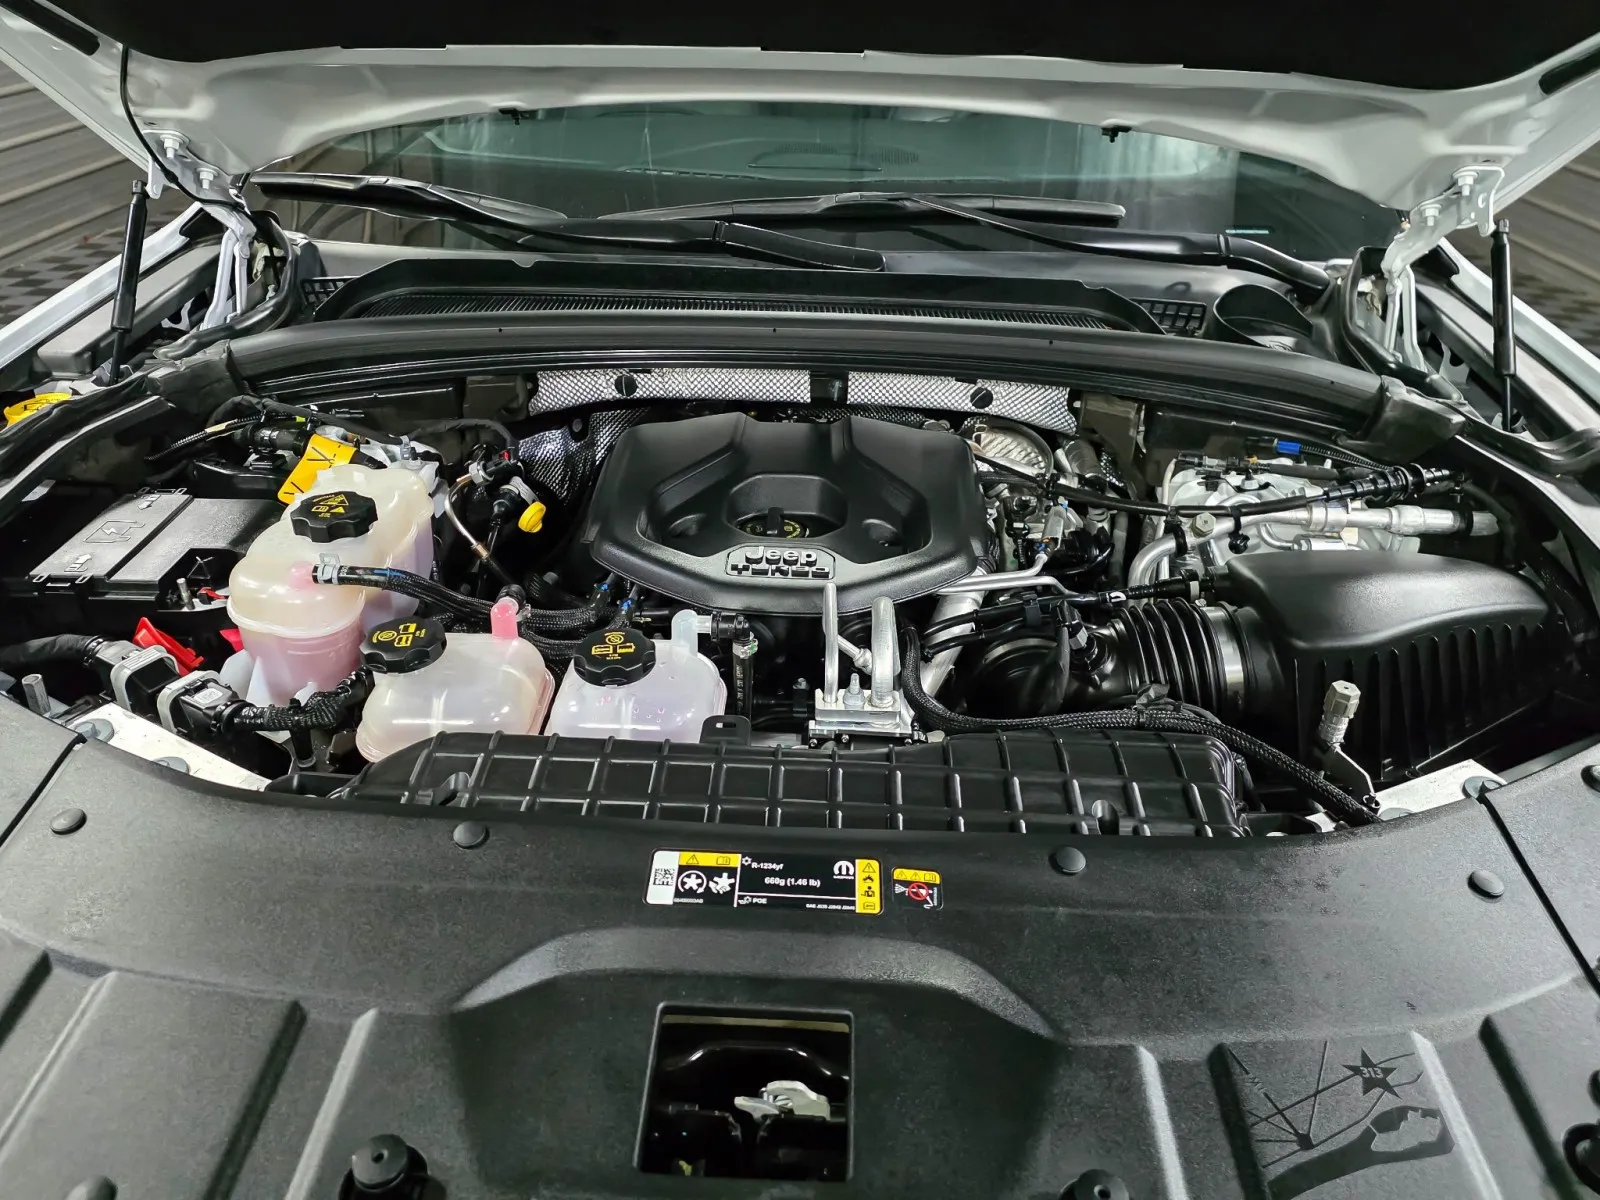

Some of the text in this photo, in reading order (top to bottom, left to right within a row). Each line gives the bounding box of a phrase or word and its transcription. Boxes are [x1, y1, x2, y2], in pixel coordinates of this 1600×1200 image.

[745, 546, 818, 567] Jeep
[751, 862, 784, 871] R-1234yf
[764, 876, 821, 889] 660g (1.46 lb)
[1359, 1066, 1384, 1079] 313
